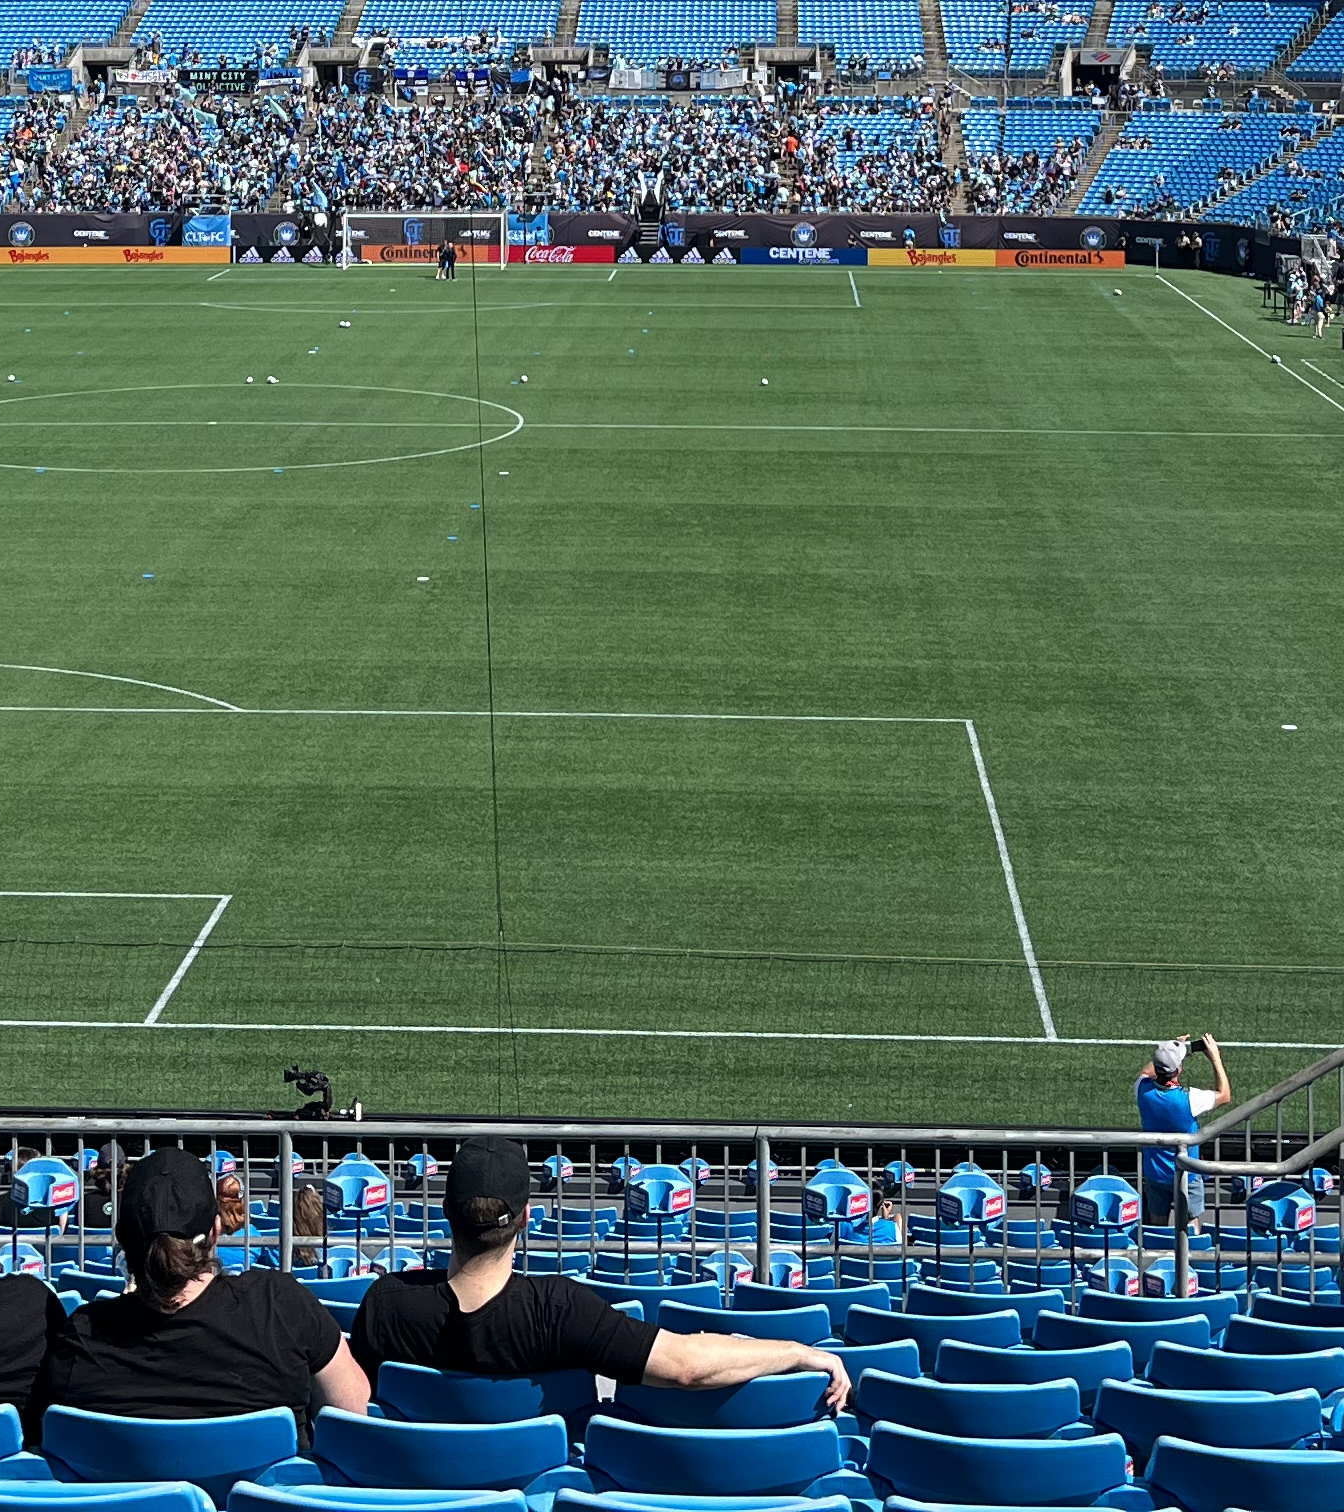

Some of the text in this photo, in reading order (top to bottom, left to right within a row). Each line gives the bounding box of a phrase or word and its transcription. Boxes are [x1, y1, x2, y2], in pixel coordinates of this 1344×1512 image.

[190, 72, 246, 81] MINT CITY
[769, 247, 830, 261] CENTENE
[907, 250, 957, 265] Bojangles
[1015, 251, 1092, 267] Continental
